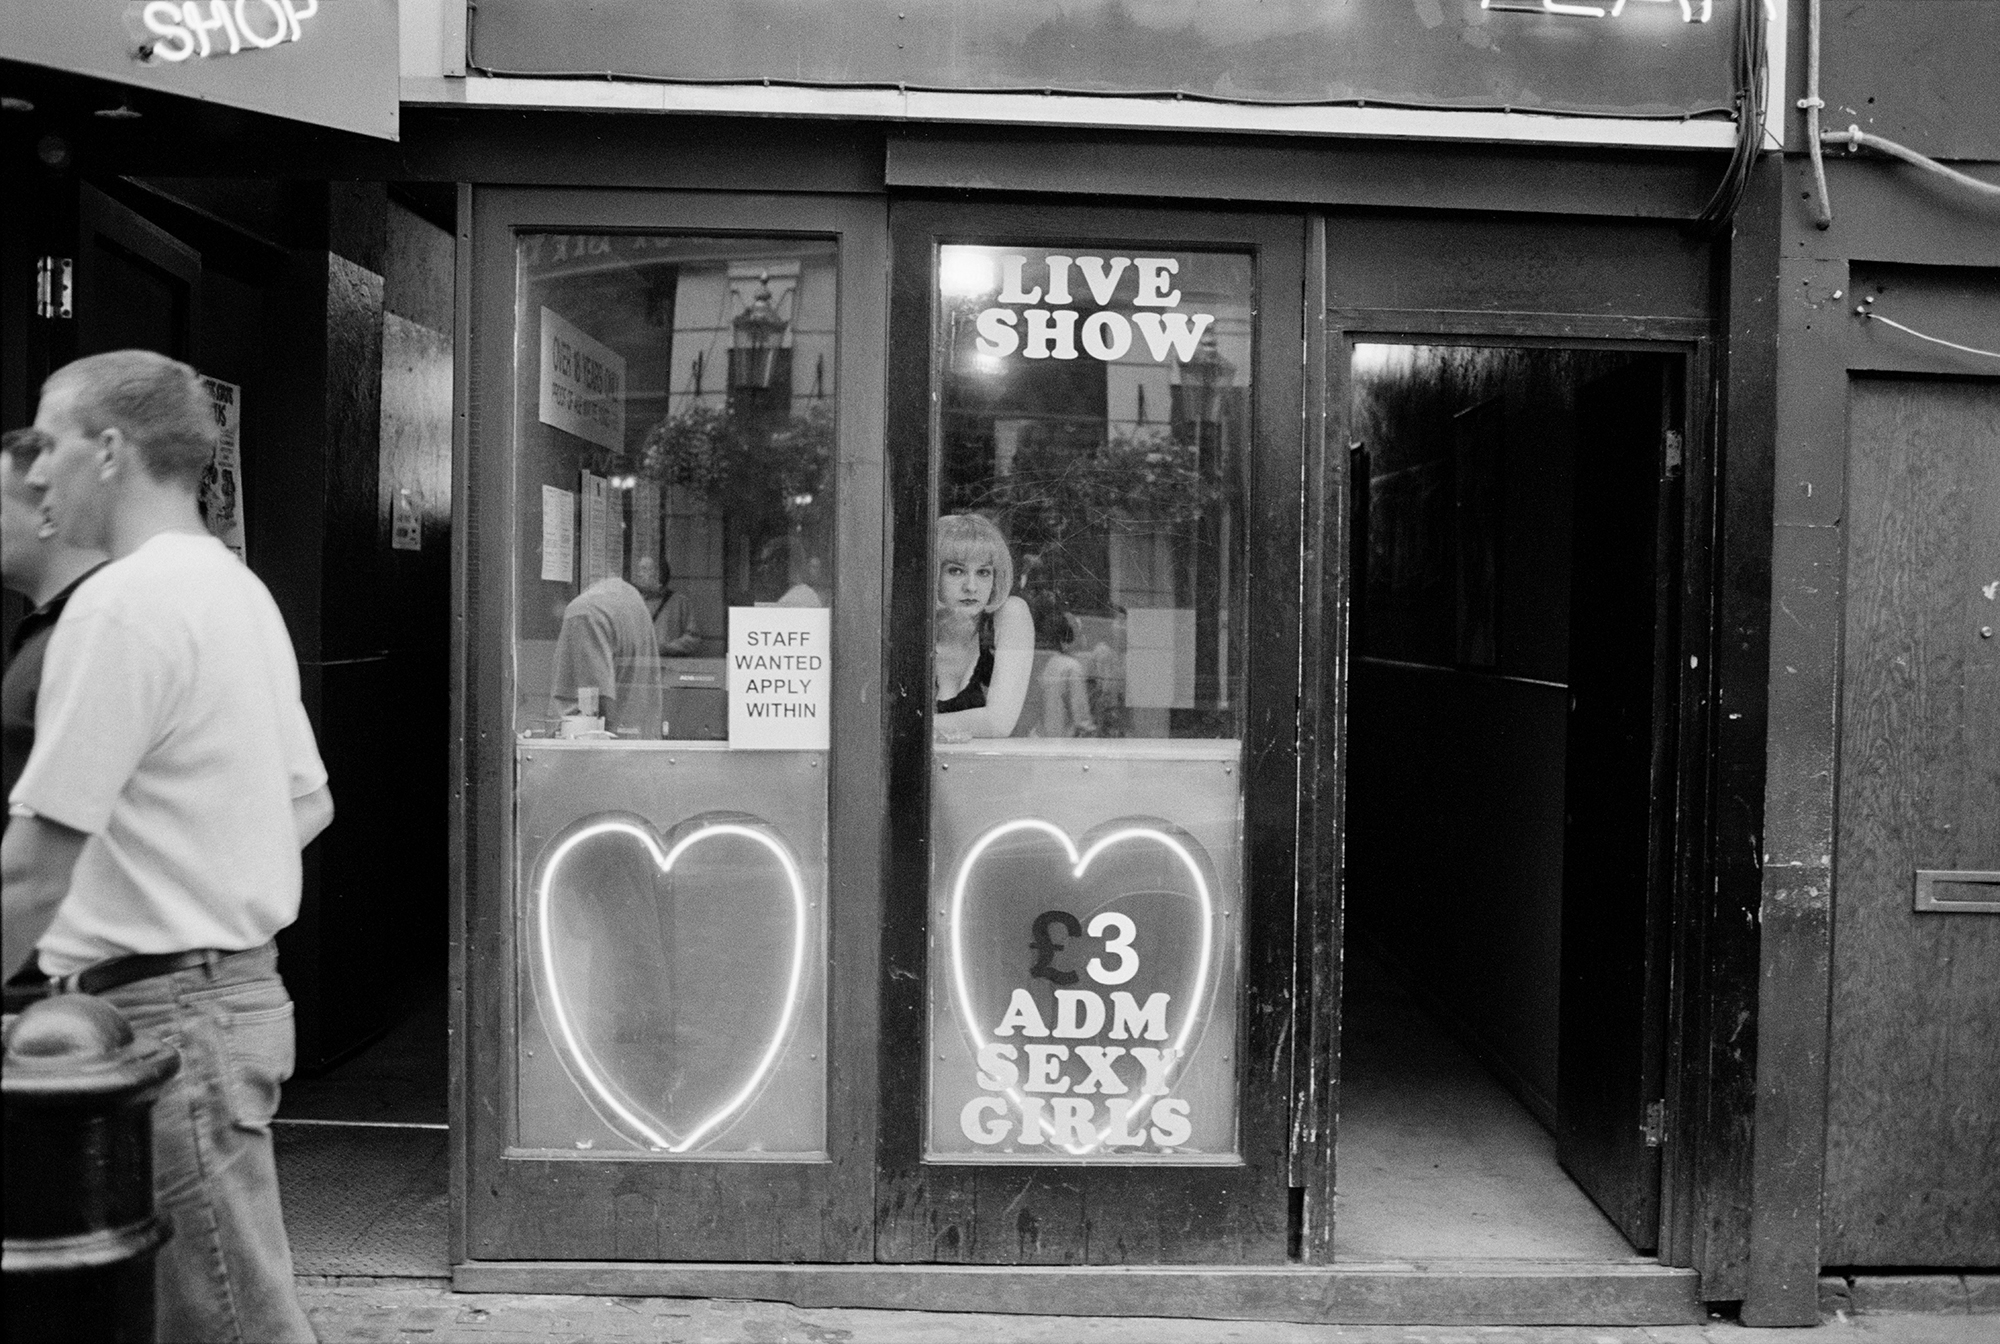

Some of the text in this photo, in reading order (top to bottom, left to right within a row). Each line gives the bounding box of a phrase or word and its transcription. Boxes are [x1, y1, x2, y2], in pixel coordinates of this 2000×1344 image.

[143, 0, 318, 62] SHOP
[997, 255, 1182, 307] LIVE
[975, 308, 1215, 363] SHOW
[734, 655, 822, 671] WANTED
[747, 631, 811, 647] STAFF
[745, 679, 812, 694] APPLY
[746, 702, 816, 718] WITHIN
[1029, 910, 1139, 985] £3
[994, 988, 1171, 1040] ADM
[976, 1043, 1183, 1095] SEXY
[960, 1096, 1192, 1147] GIRLS
